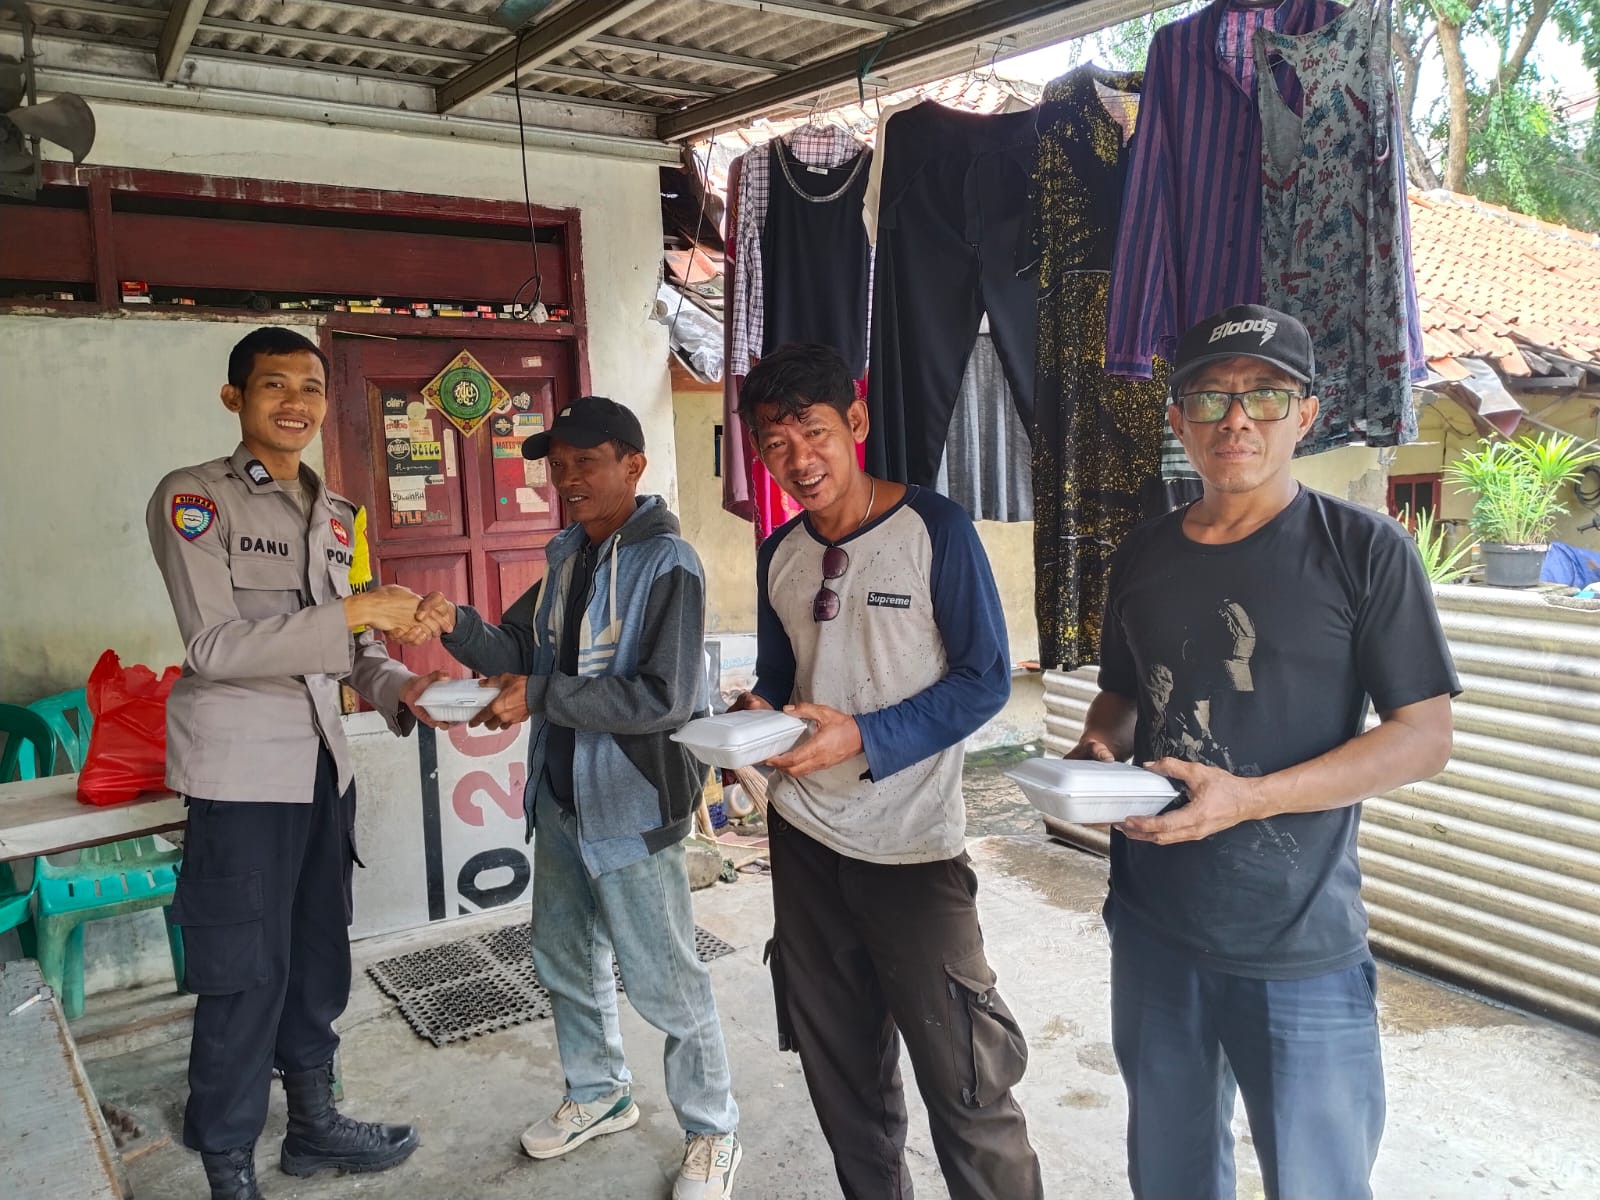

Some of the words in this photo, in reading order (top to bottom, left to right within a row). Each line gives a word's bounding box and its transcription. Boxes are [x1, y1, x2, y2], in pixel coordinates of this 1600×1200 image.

[1208, 318, 1278, 346] Bloods
[240, 537, 288, 556] DANU
[869, 593, 910, 605] Supreme
[715, 1150, 732, 1169] N
